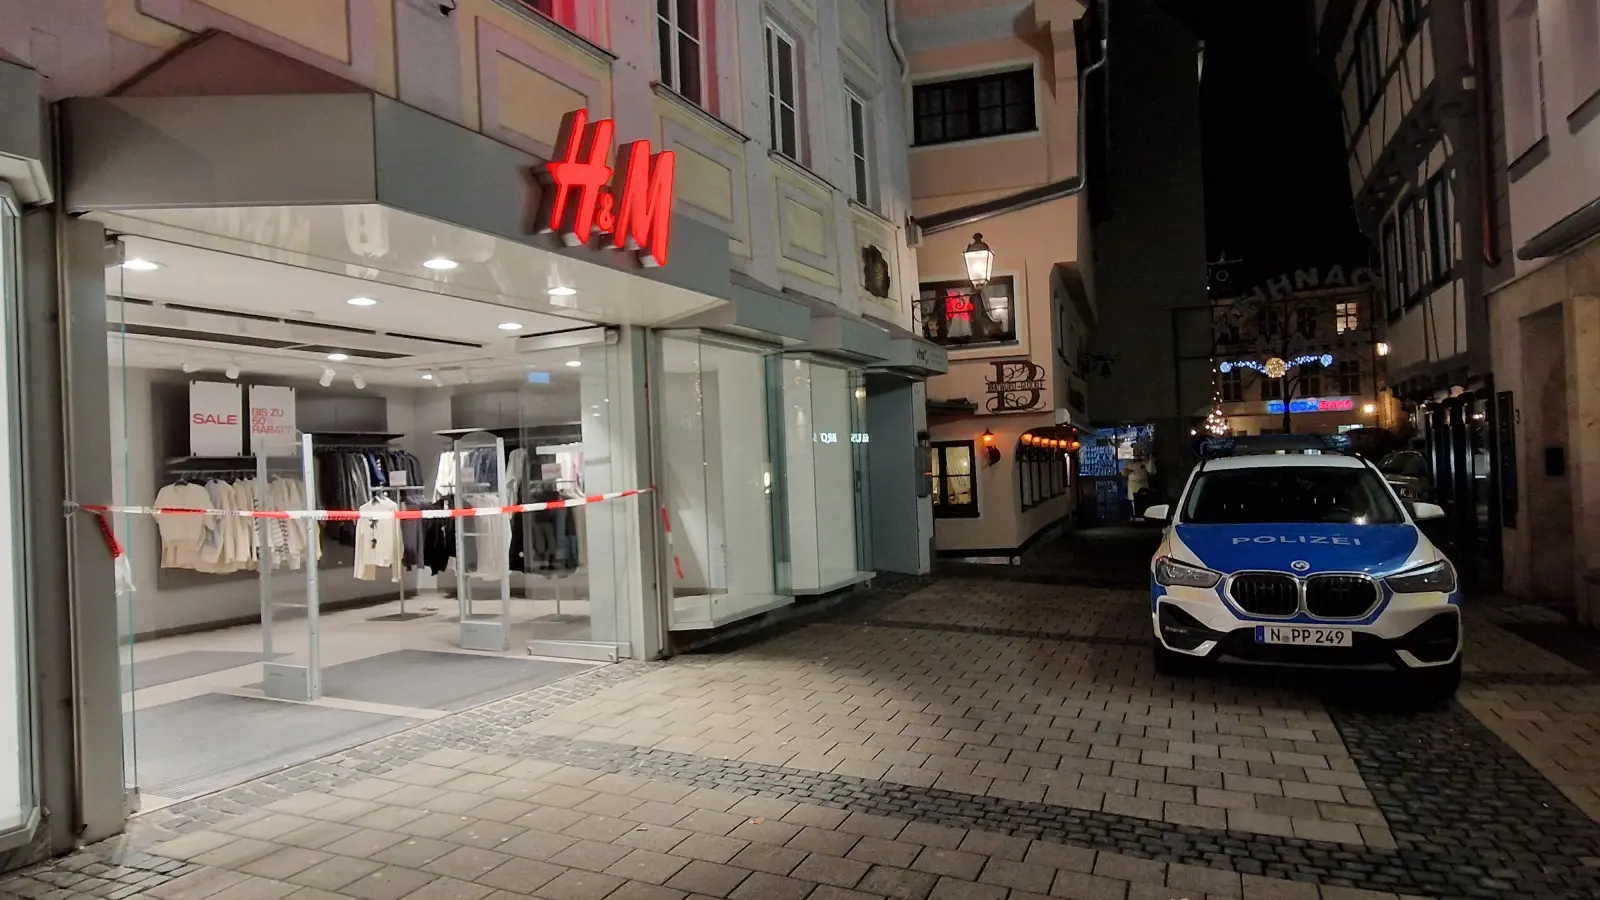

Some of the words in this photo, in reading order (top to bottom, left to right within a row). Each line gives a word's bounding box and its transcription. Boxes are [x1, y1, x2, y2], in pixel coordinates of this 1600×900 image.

[545, 108, 676, 268] H&M
[193, 413, 238, 425] SALE
[270, 409, 284, 417] ZU
[1232, 535, 1362, 546] POLIZEI
[1270, 628, 1281, 642] N
[1291, 629, 1311, 643] PP
[1315, 630, 1345, 644] 249
